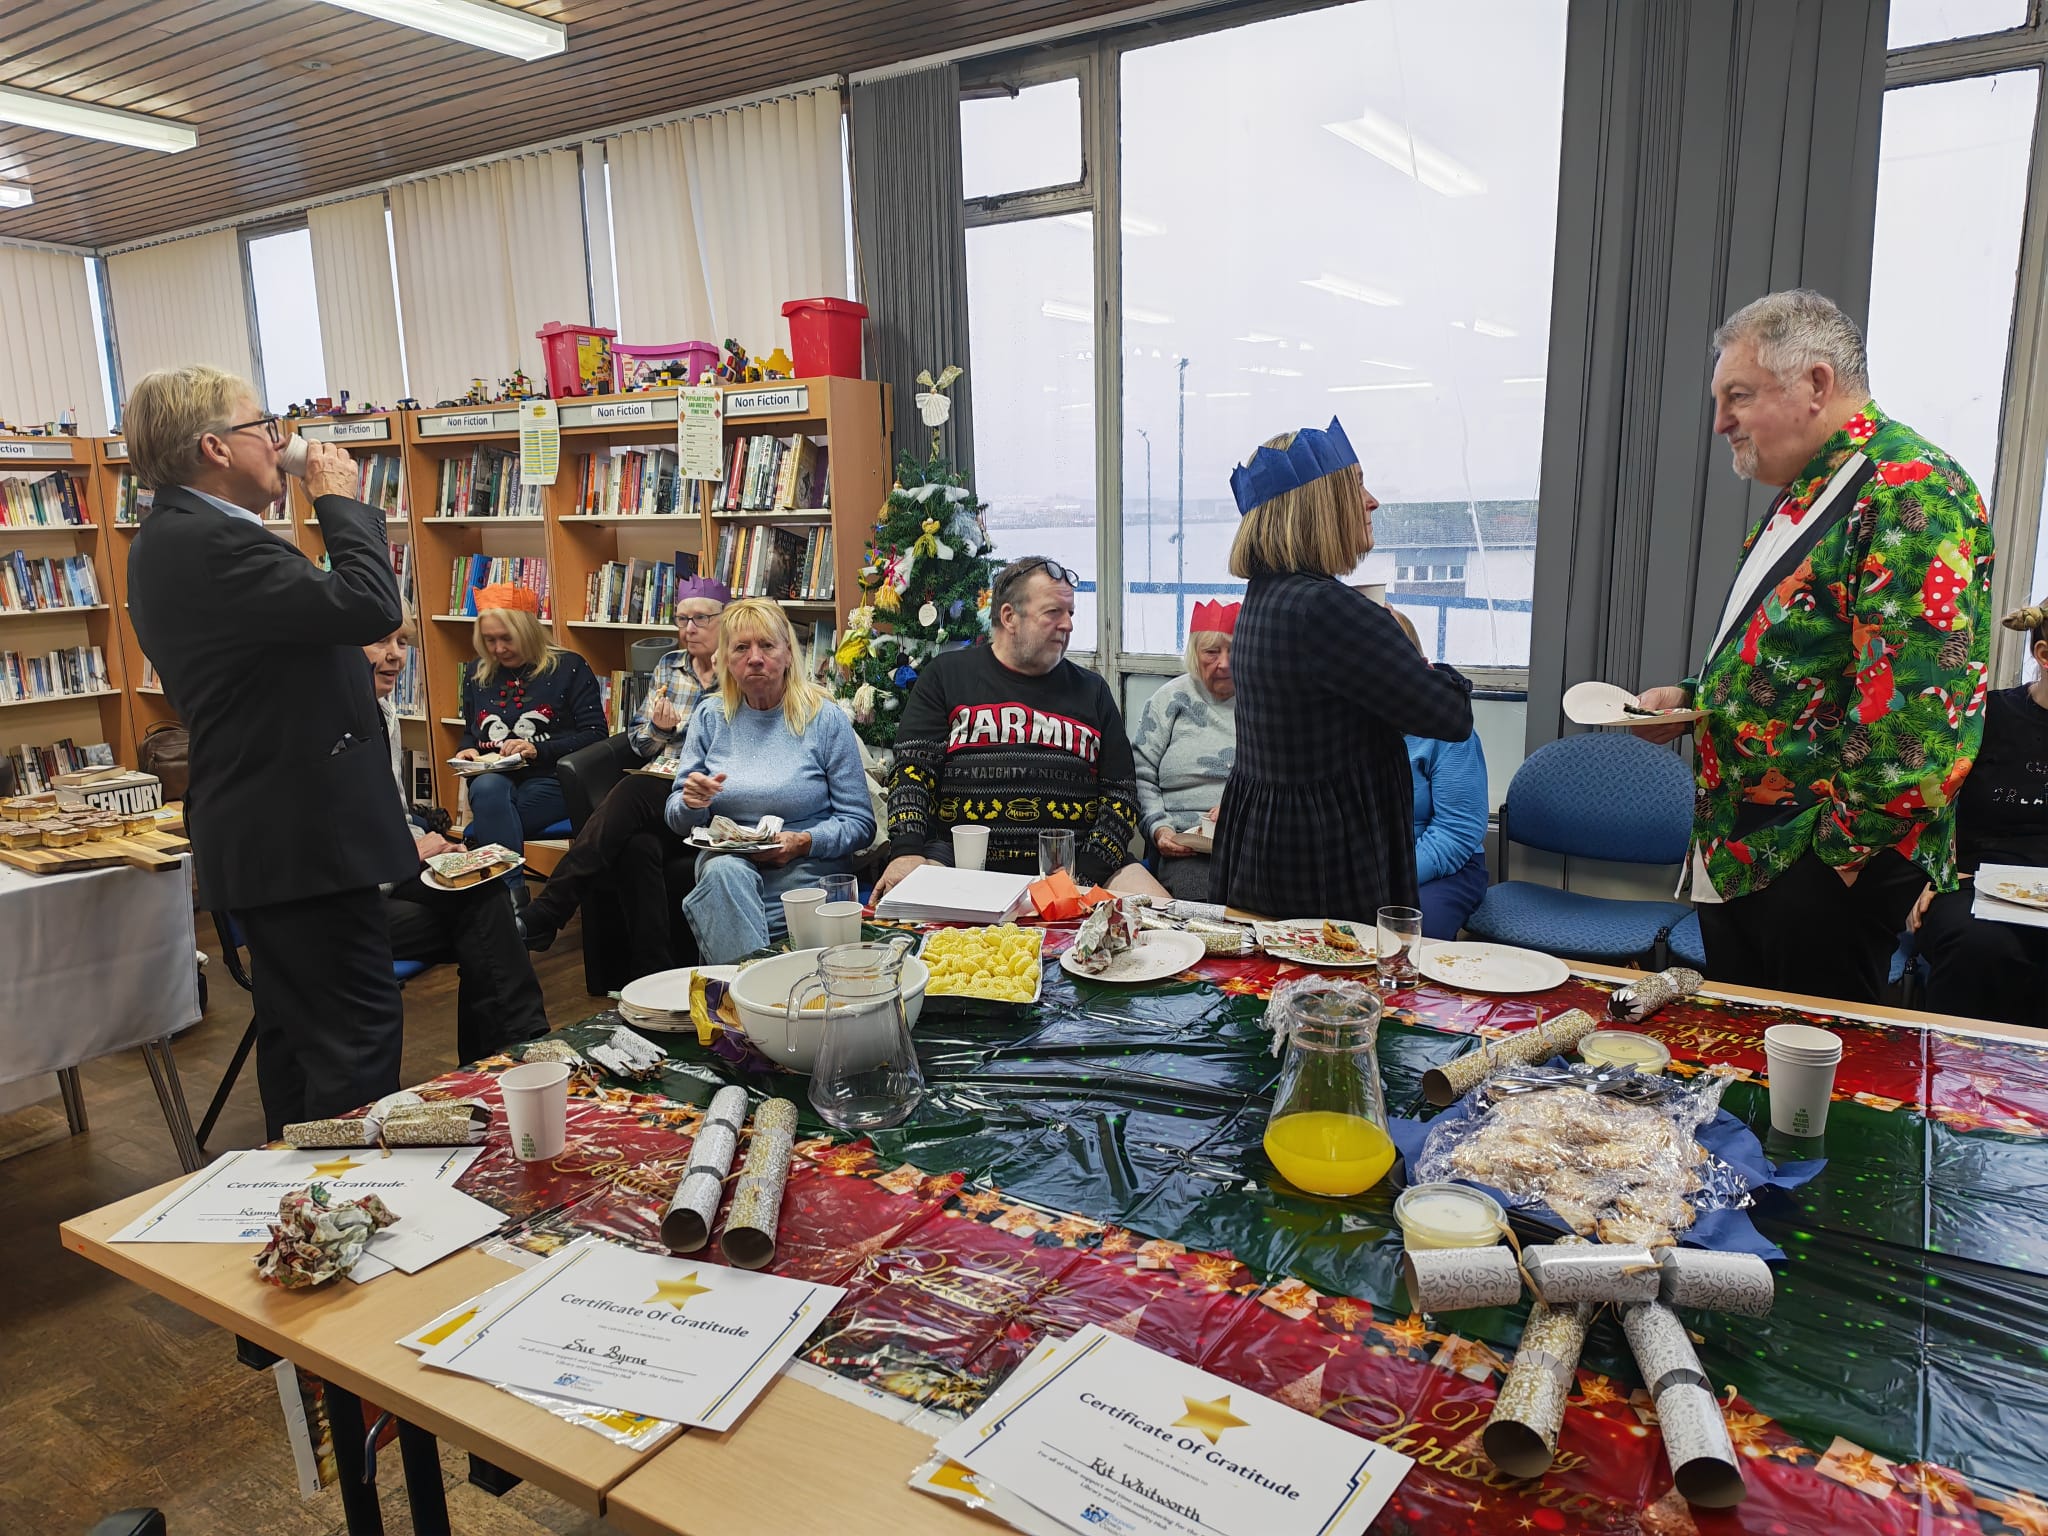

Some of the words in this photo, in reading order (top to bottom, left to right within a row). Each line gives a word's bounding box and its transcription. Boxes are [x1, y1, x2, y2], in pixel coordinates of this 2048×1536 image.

[597, 406, 615, 418] Non
[617, 403, 645, 416] Fiction
[735, 397, 755, 408] Non
[757, 394, 790, 406] Fiction
[333, 425, 346, 435] Non
[348, 424, 371, 434] Fiction
[447, 417, 461, 427] Non
[463, 415, 488, 427] Fiction
[971, 767, 1027, 779] NAUGHTY
[87, 783, 163, 815] CENTURY
[227, 1181, 306, 1189] Certificate
[333, 1180, 405, 1188] Gratitude
[560, 1293, 644, 1317] Certificate
[647, 1309, 670, 1321] Of
[671, 1314, 750, 1338] Gratitude
[602, 1345, 648, 1365] Byrne
[1079, 1391, 1173, 1443] Certificate
[1176, 1437, 1206, 1455] Of
[1205, 1450, 1301, 1501] Gratitude
[1080, 1472, 1105, 1489] support
[1105, 1486, 1118, 1496] and
[1080, 1482, 1102, 1497] Library
[1102, 1493, 1115, 1504] and
[1115, 1500, 1152, 1524] Community
[1153, 1519, 1168, 1531] Hub
[1120, 1473, 1201, 1523] Whitworth
